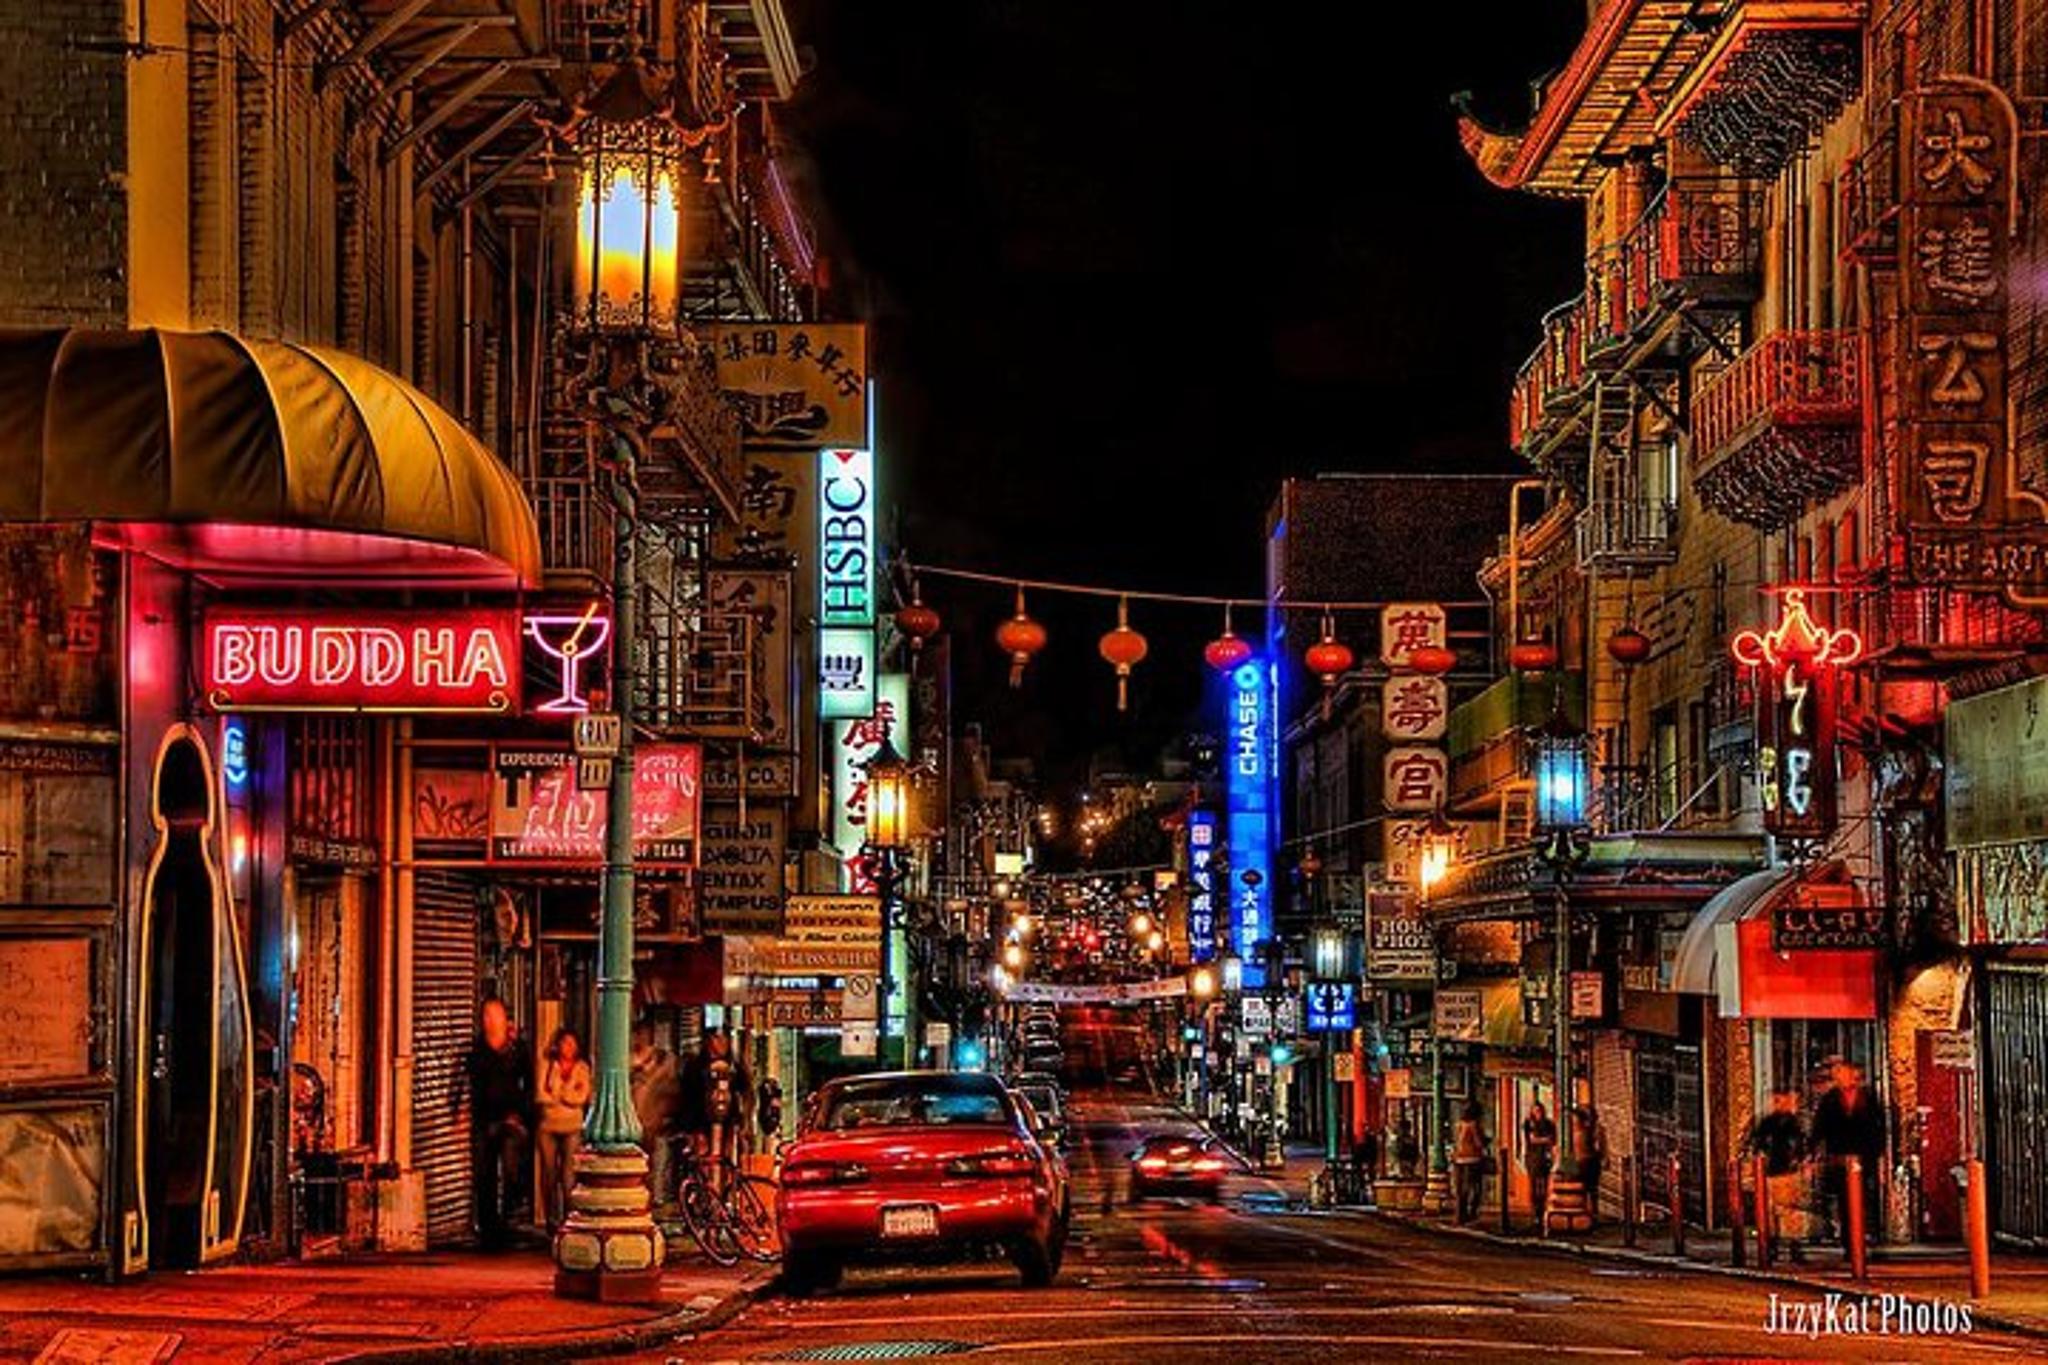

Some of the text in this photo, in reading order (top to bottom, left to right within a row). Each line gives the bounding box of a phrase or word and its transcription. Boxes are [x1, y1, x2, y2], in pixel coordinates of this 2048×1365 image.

[823, 477, 867, 615] HSBC
[1912, 542, 2048, 571] THE ART
[211, 624, 507, 687] BUDDHA
[1388, 610, 1444, 803] 萬壽宮
[1239, 690, 1258, 776] CHASE
[501, 752, 566, 767] EXPERIENCE
[653, 844, 687, 858] TEAS
[704, 873, 765, 890] ENTAX
[701, 894, 784, 912] YMPUS
